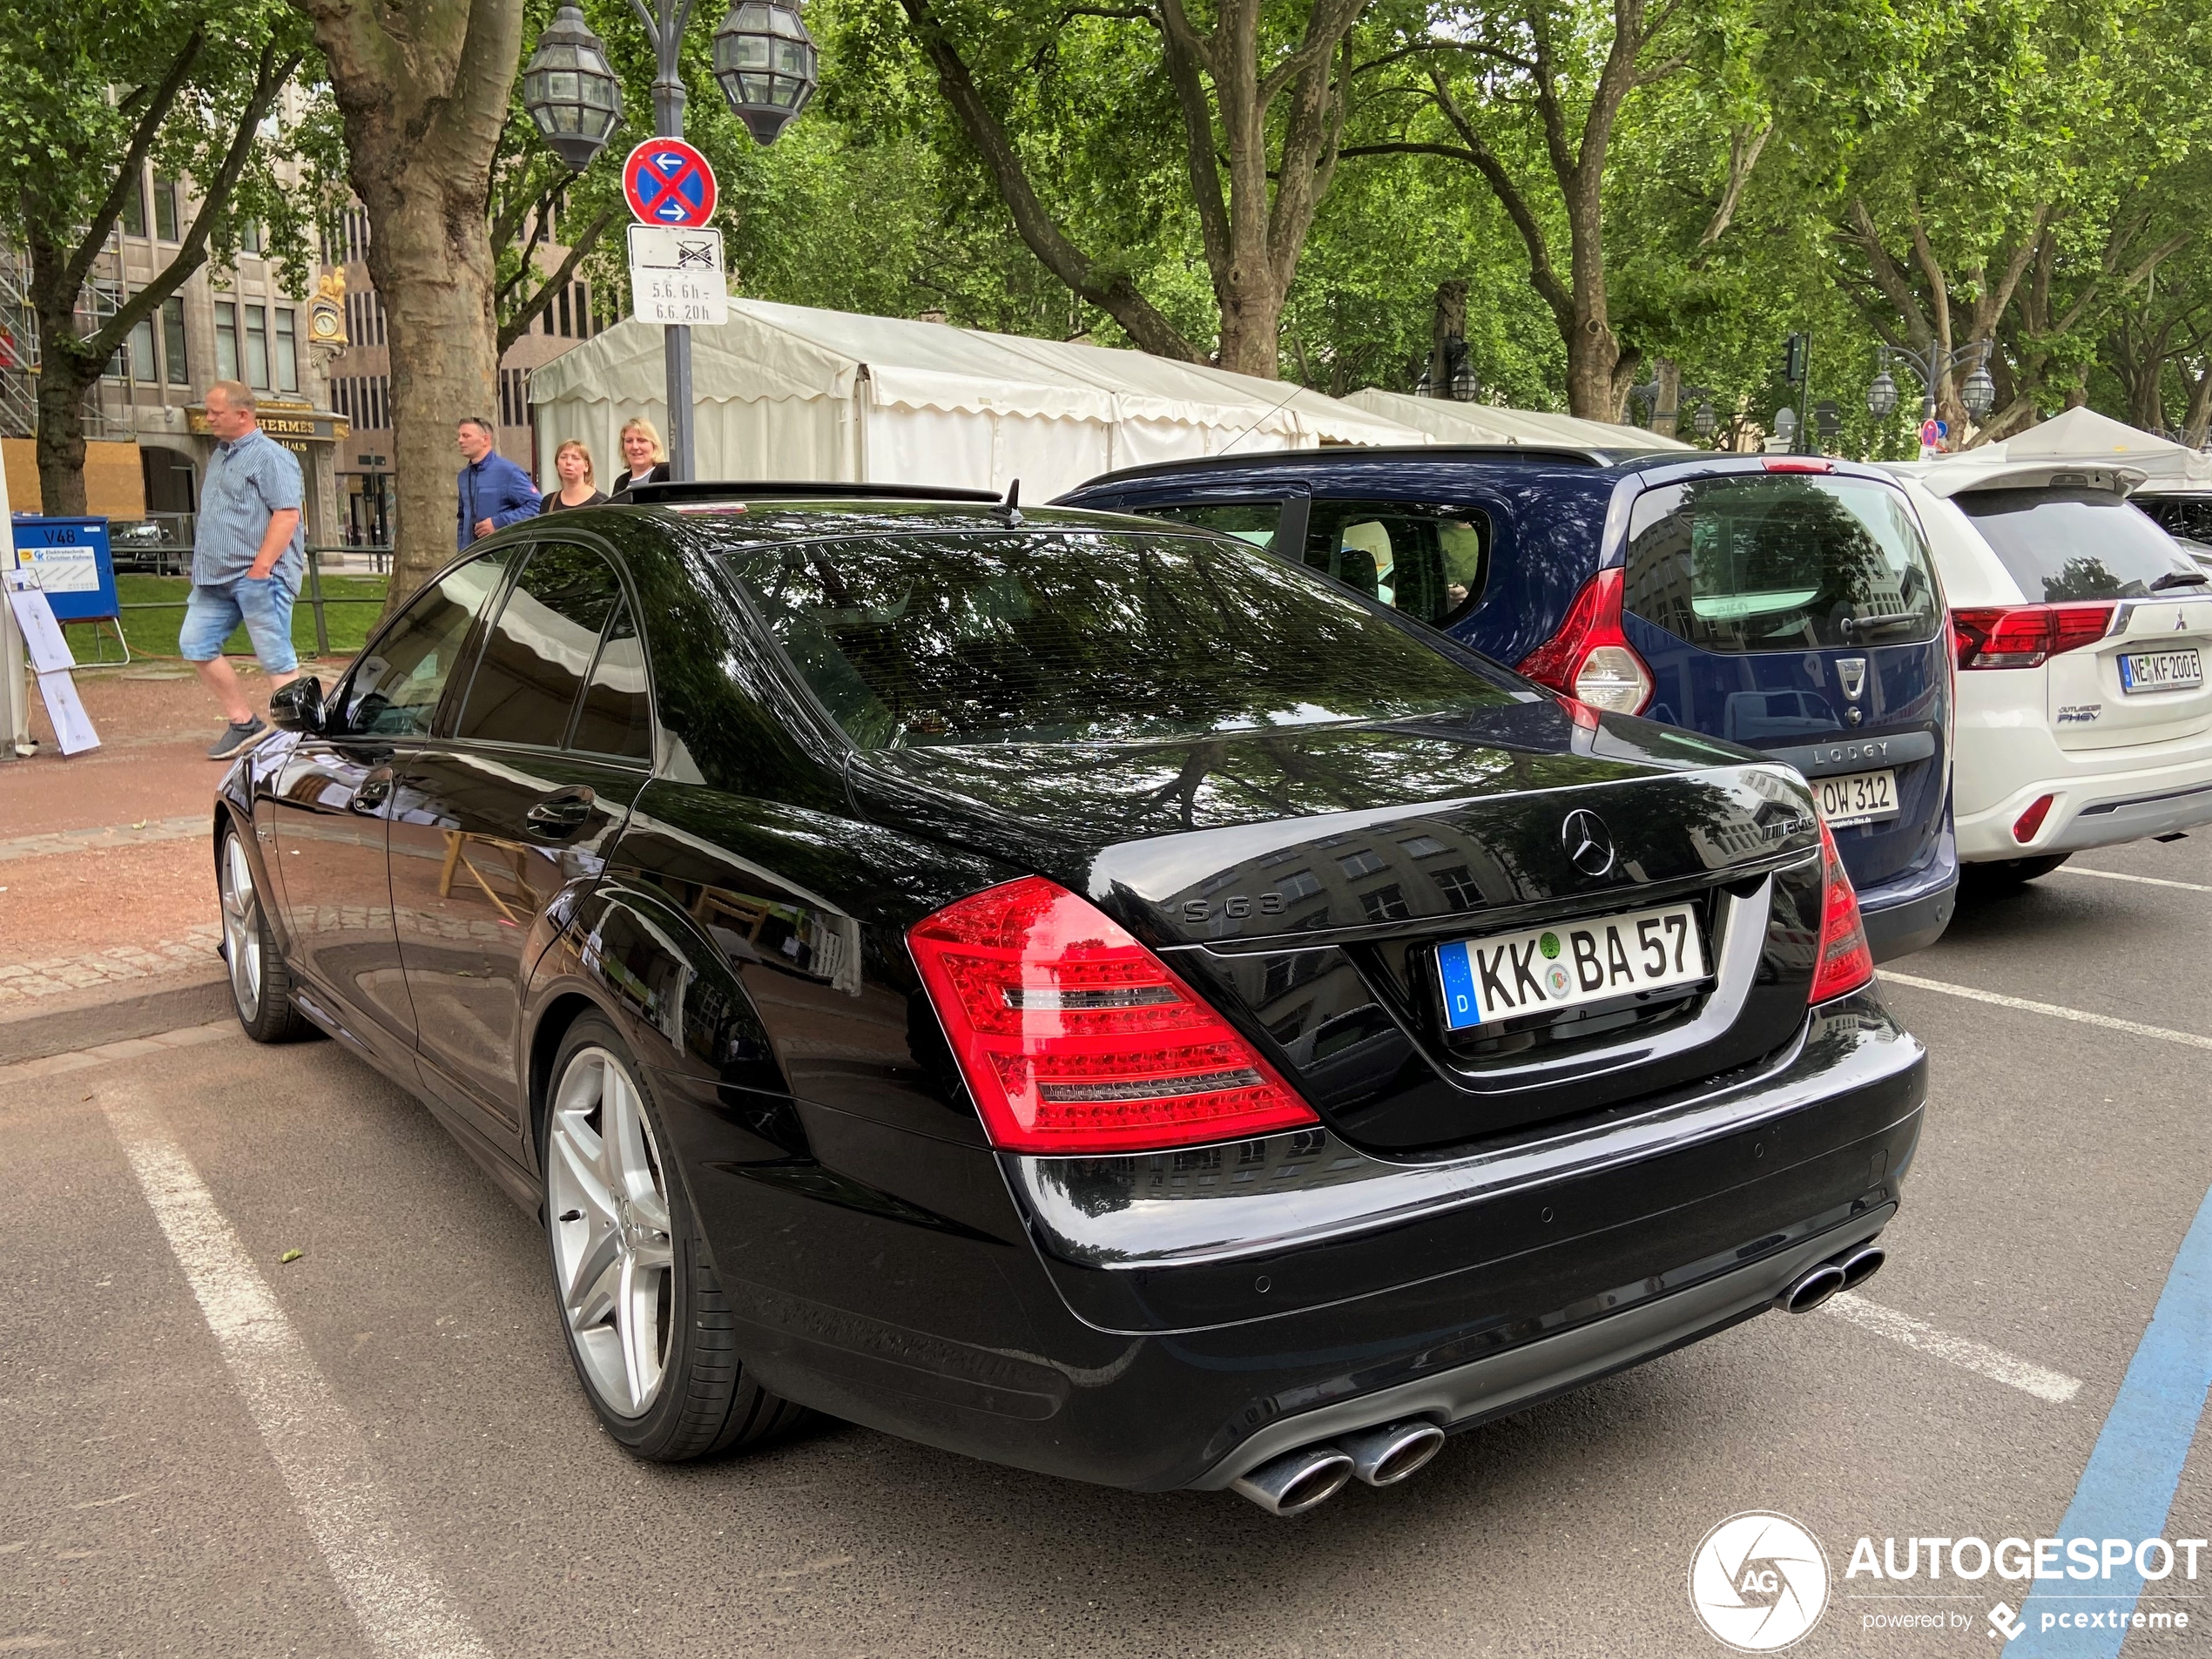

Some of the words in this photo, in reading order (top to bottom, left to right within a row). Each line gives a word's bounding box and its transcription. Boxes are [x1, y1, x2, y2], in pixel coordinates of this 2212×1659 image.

[657, 305, 678, 319] 6.6.
[44, 529, 76, 545] V48
[2130, 658, 2148, 683] NE
[2153, 657, 2168, 681] KF
[2169, 655, 2191, 679] 200
[2191, 655, 2200, 678] E
[2057, 711, 2101, 724] PHEV
[2059, 704, 2101, 713] OUTLANDER
[1813, 742, 1887, 765] LODGY
[1824, 780, 1850, 814] OW
[1853, 776, 1890, 811] 312
[1184, 900, 1211, 923] S
[1225, 892, 1286, 920] 63
[1476, 940, 1547, 1011] KK
[1570, 926, 1634, 992] BA
[1636, 914, 1687, 978] 57
[1457, 995, 1469, 1013] D
